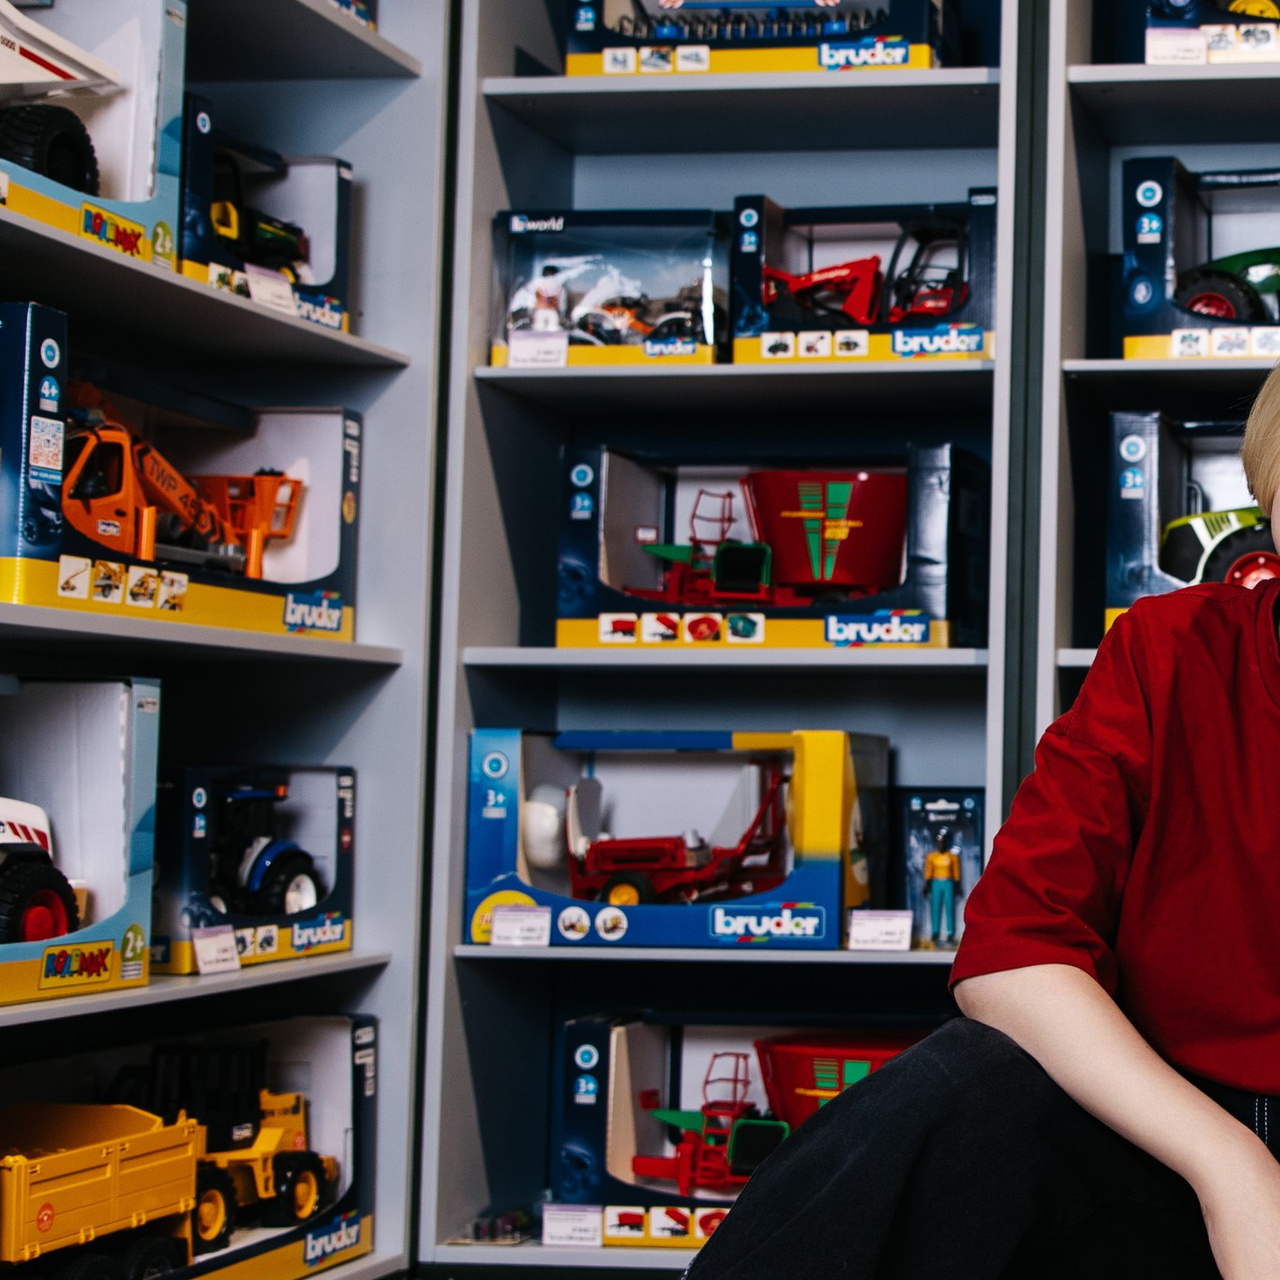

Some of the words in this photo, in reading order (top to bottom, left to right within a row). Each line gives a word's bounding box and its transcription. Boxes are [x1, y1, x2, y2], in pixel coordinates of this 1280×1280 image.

[820, 41, 907, 65] bruder
[1140, 218, 1160, 233] 3+
[154, 225, 173, 253] 2+
[644, 338, 696, 356] bruder
[894, 330, 981, 353] bruder
[40, 379, 59, 399] 4+
[1124, 470, 1144, 488] 3+
[285, 594, 342, 629] bruder
[828, 615, 925, 641] bruder
[486, 790, 506, 806] 3+
[714, 908, 819, 935] bruder
[125, 930, 145, 954] 2+
[292, 922, 344, 947] bruder
[578, 1079, 596, 1095] 3+
[305, 1219, 361, 1258] bruder
